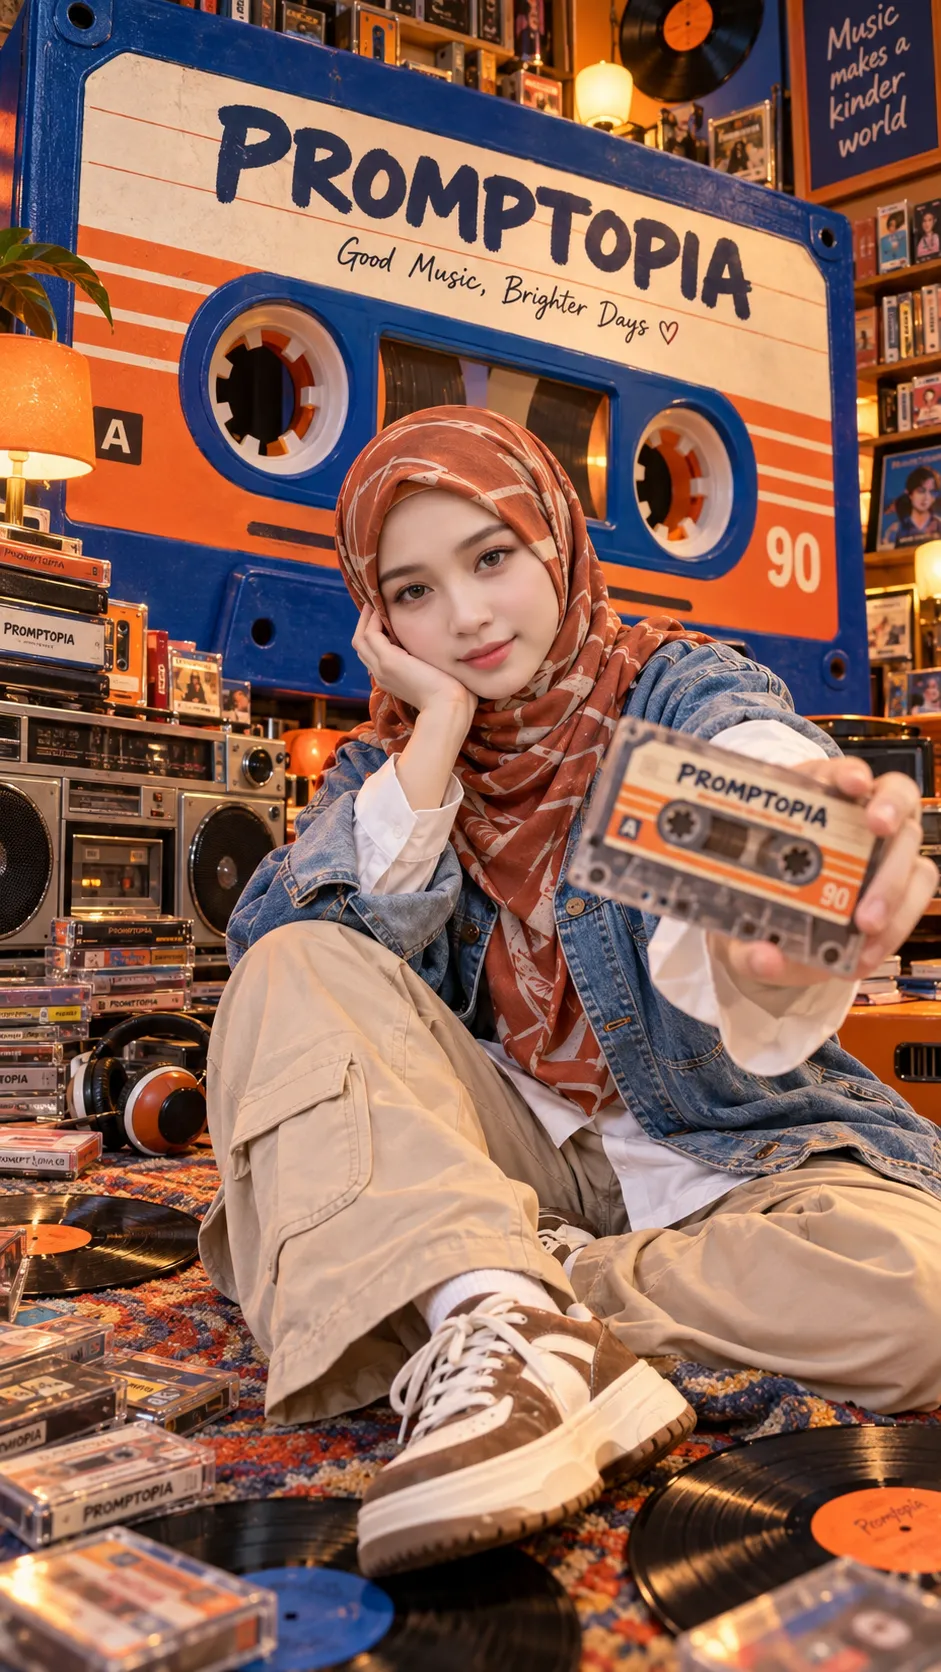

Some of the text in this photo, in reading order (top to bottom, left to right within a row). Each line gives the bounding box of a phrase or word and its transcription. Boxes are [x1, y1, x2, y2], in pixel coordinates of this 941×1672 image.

[827, 3, 899, 61] Music
[830, 36, 911, 91] makes a
[829, 72, 906, 130] kinder
[838, 95, 907, 158] world
[216, 104, 752, 321] PROMPTOPIA
[337, 236, 650, 344] Good Music, Brighter Days
[101, 418, 131, 454] A
[766, 525, 821, 594] 90
[4, 621, 75, 646] PROMPTOPIA
[676, 762, 828, 828] PROMPTOPIA
[620, 818, 639, 838] A
[819, 883, 850, 912] 90
[83, 1481, 173, 1523] PROMPTOPIA
